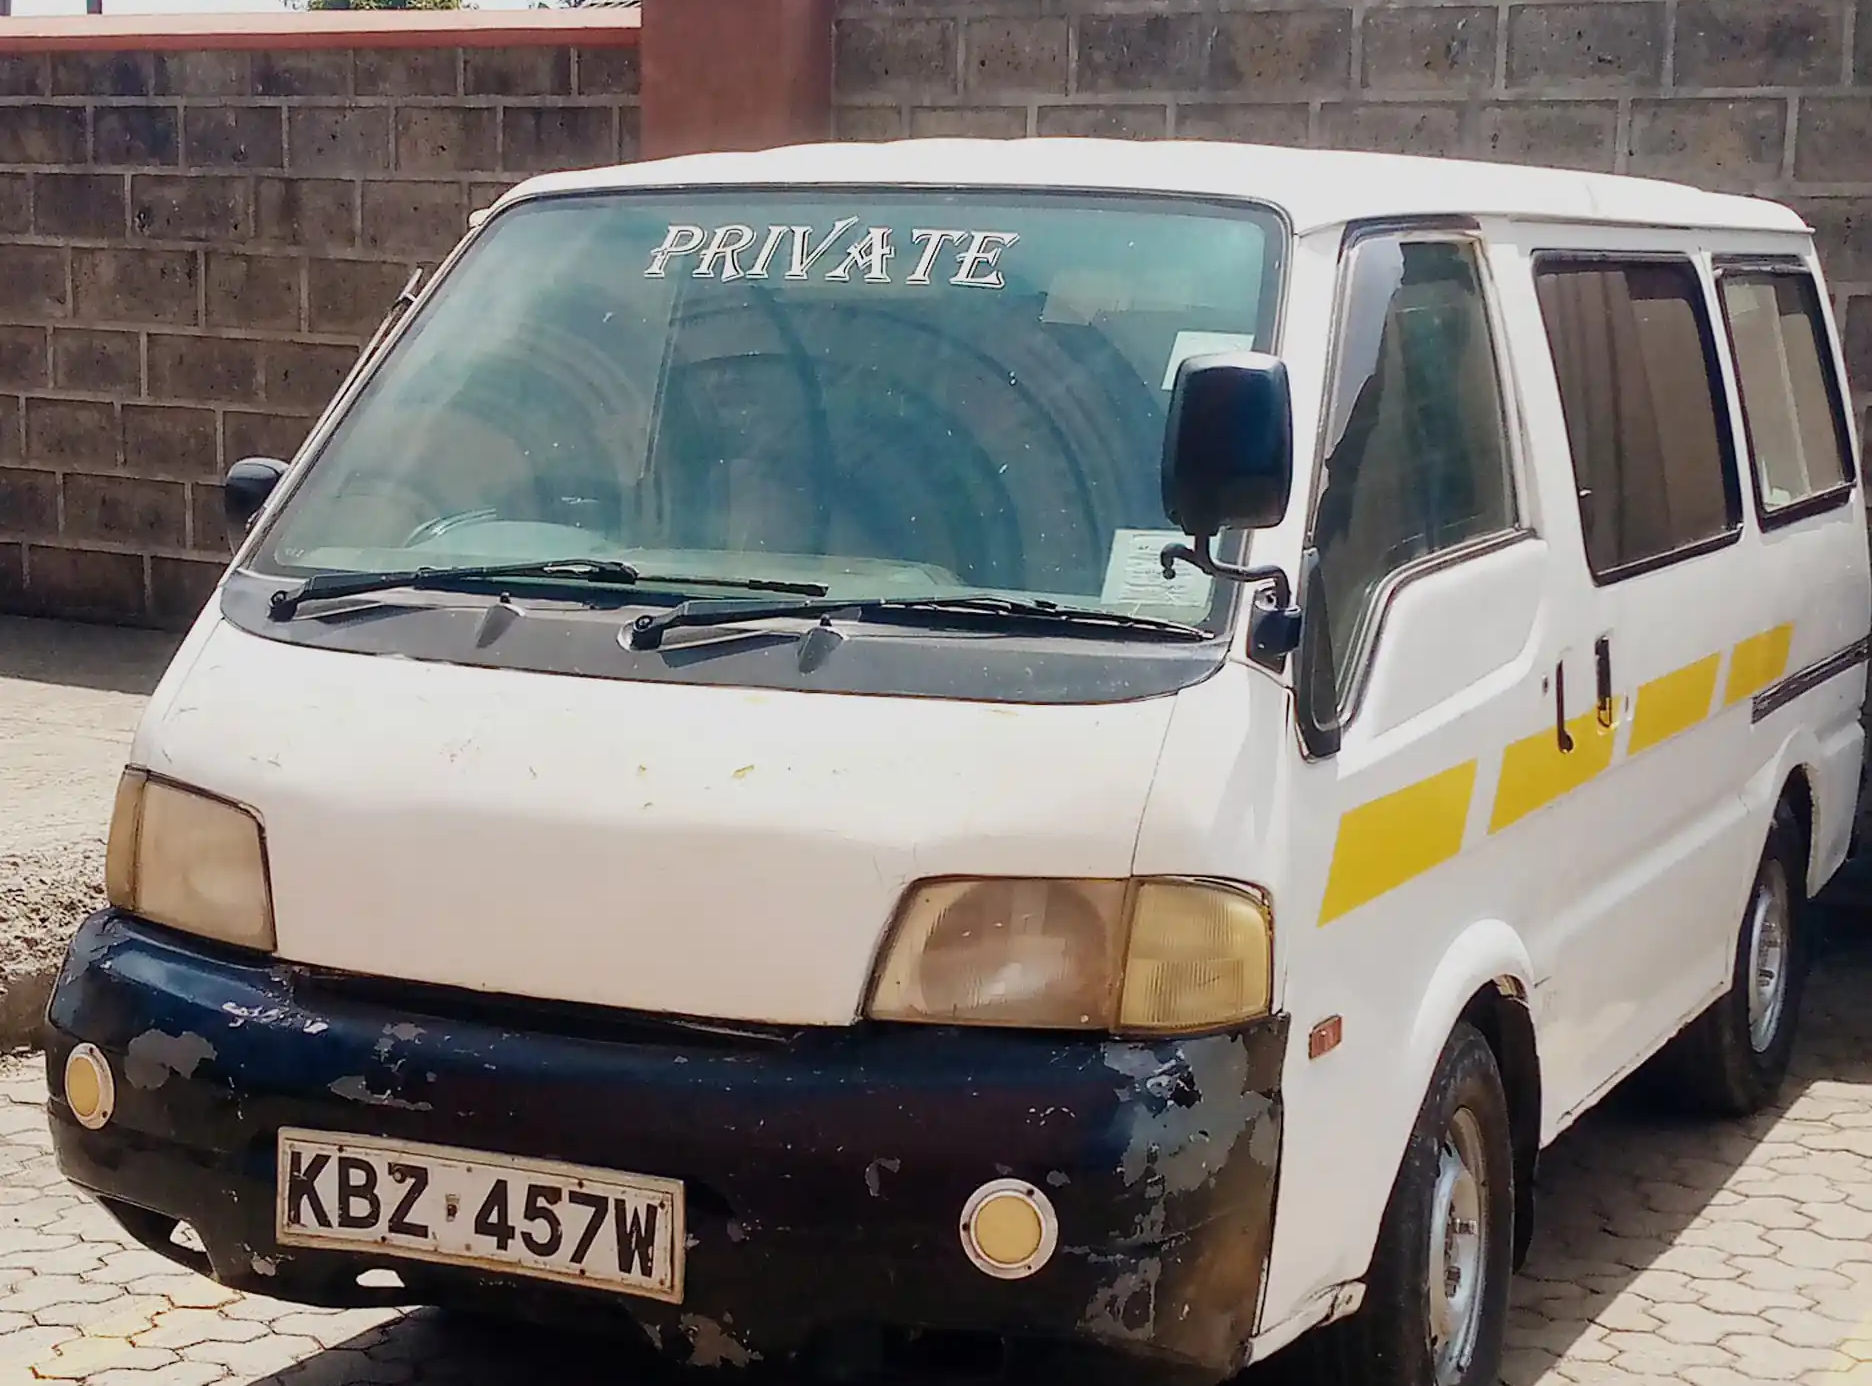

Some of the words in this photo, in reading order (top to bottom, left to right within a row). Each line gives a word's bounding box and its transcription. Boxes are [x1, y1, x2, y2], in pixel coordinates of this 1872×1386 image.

[644, 215, 1021, 289] PRIVATE
[288, 1150, 430, 1239] KBZ
[474, 1178, 658, 1279] 457W
